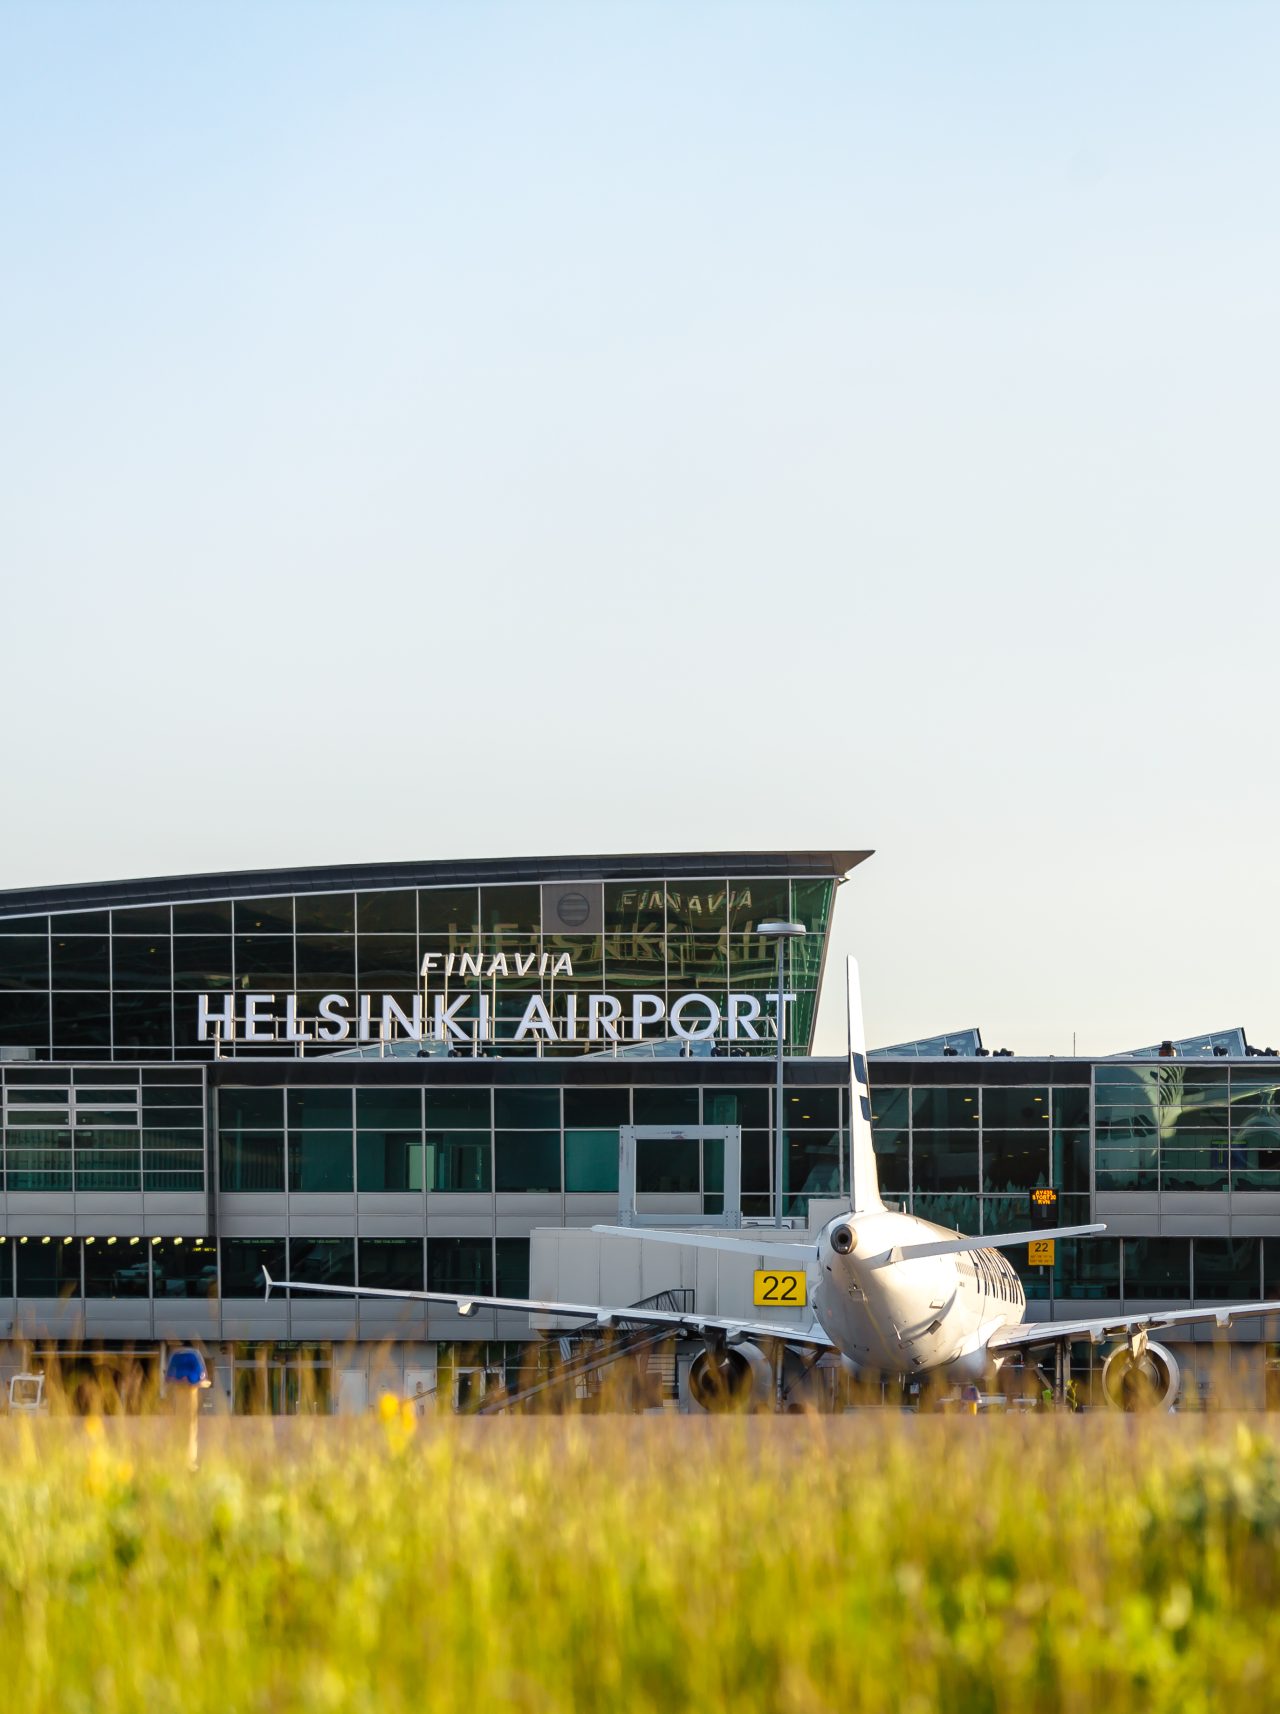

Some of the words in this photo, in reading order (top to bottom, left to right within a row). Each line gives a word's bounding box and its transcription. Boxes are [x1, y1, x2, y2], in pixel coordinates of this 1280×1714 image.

[420, 952, 574, 977] FINAVIA
[197, 994, 490, 1041] HELSINKI
[513, 993, 797, 1041] AIRPORT
[1034, 1242, 1049, 1253] 22
[762, 1275, 797, 1301] 22
